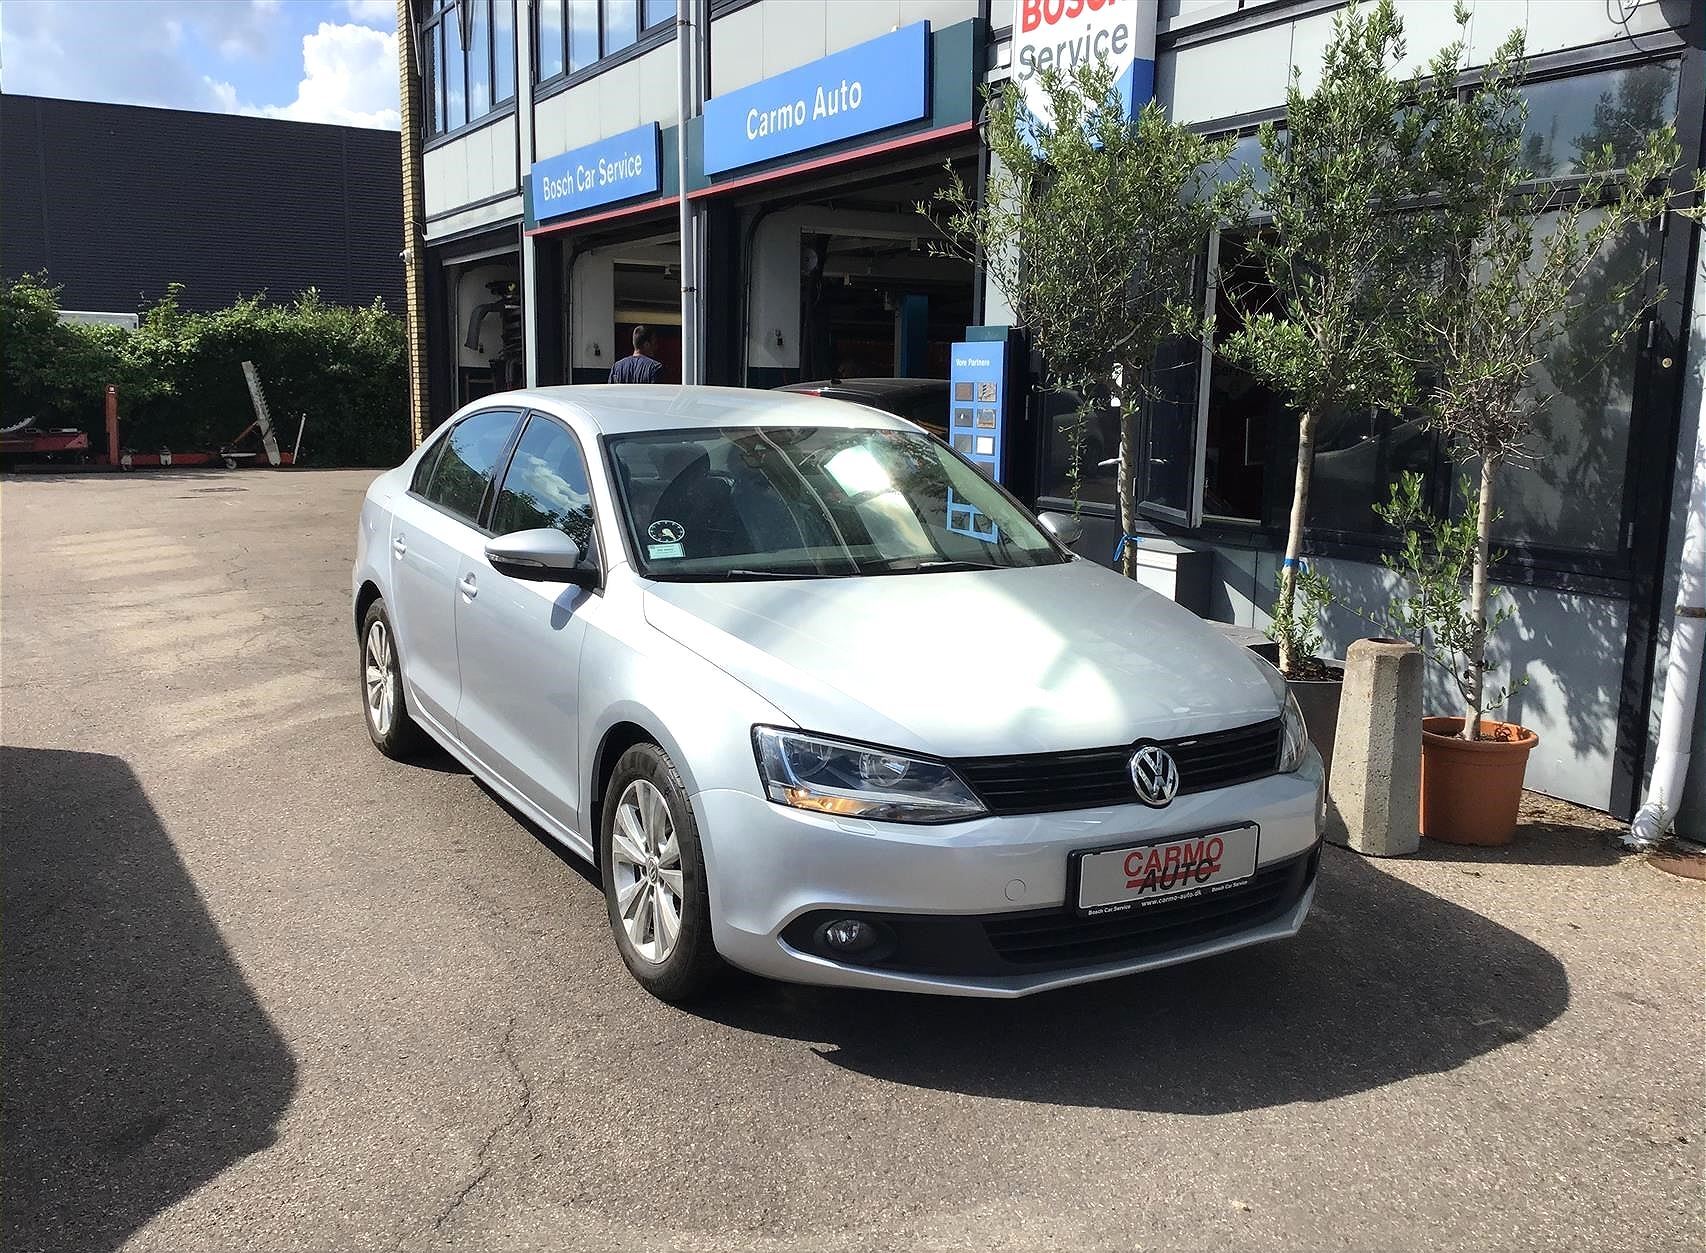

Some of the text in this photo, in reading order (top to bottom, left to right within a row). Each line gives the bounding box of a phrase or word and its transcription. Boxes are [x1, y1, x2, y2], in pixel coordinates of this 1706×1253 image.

[1018, 23, 1129, 81] Service
[746, 79, 862, 140] Carmo Auto
[543, 152, 642, 201] Bosch Car Service
[1123, 836, 1225, 878] CARMO
[1137, 857, 1214, 895] AUTO
[1141, 889, 1202, 907] www.carmo-auto.dk
